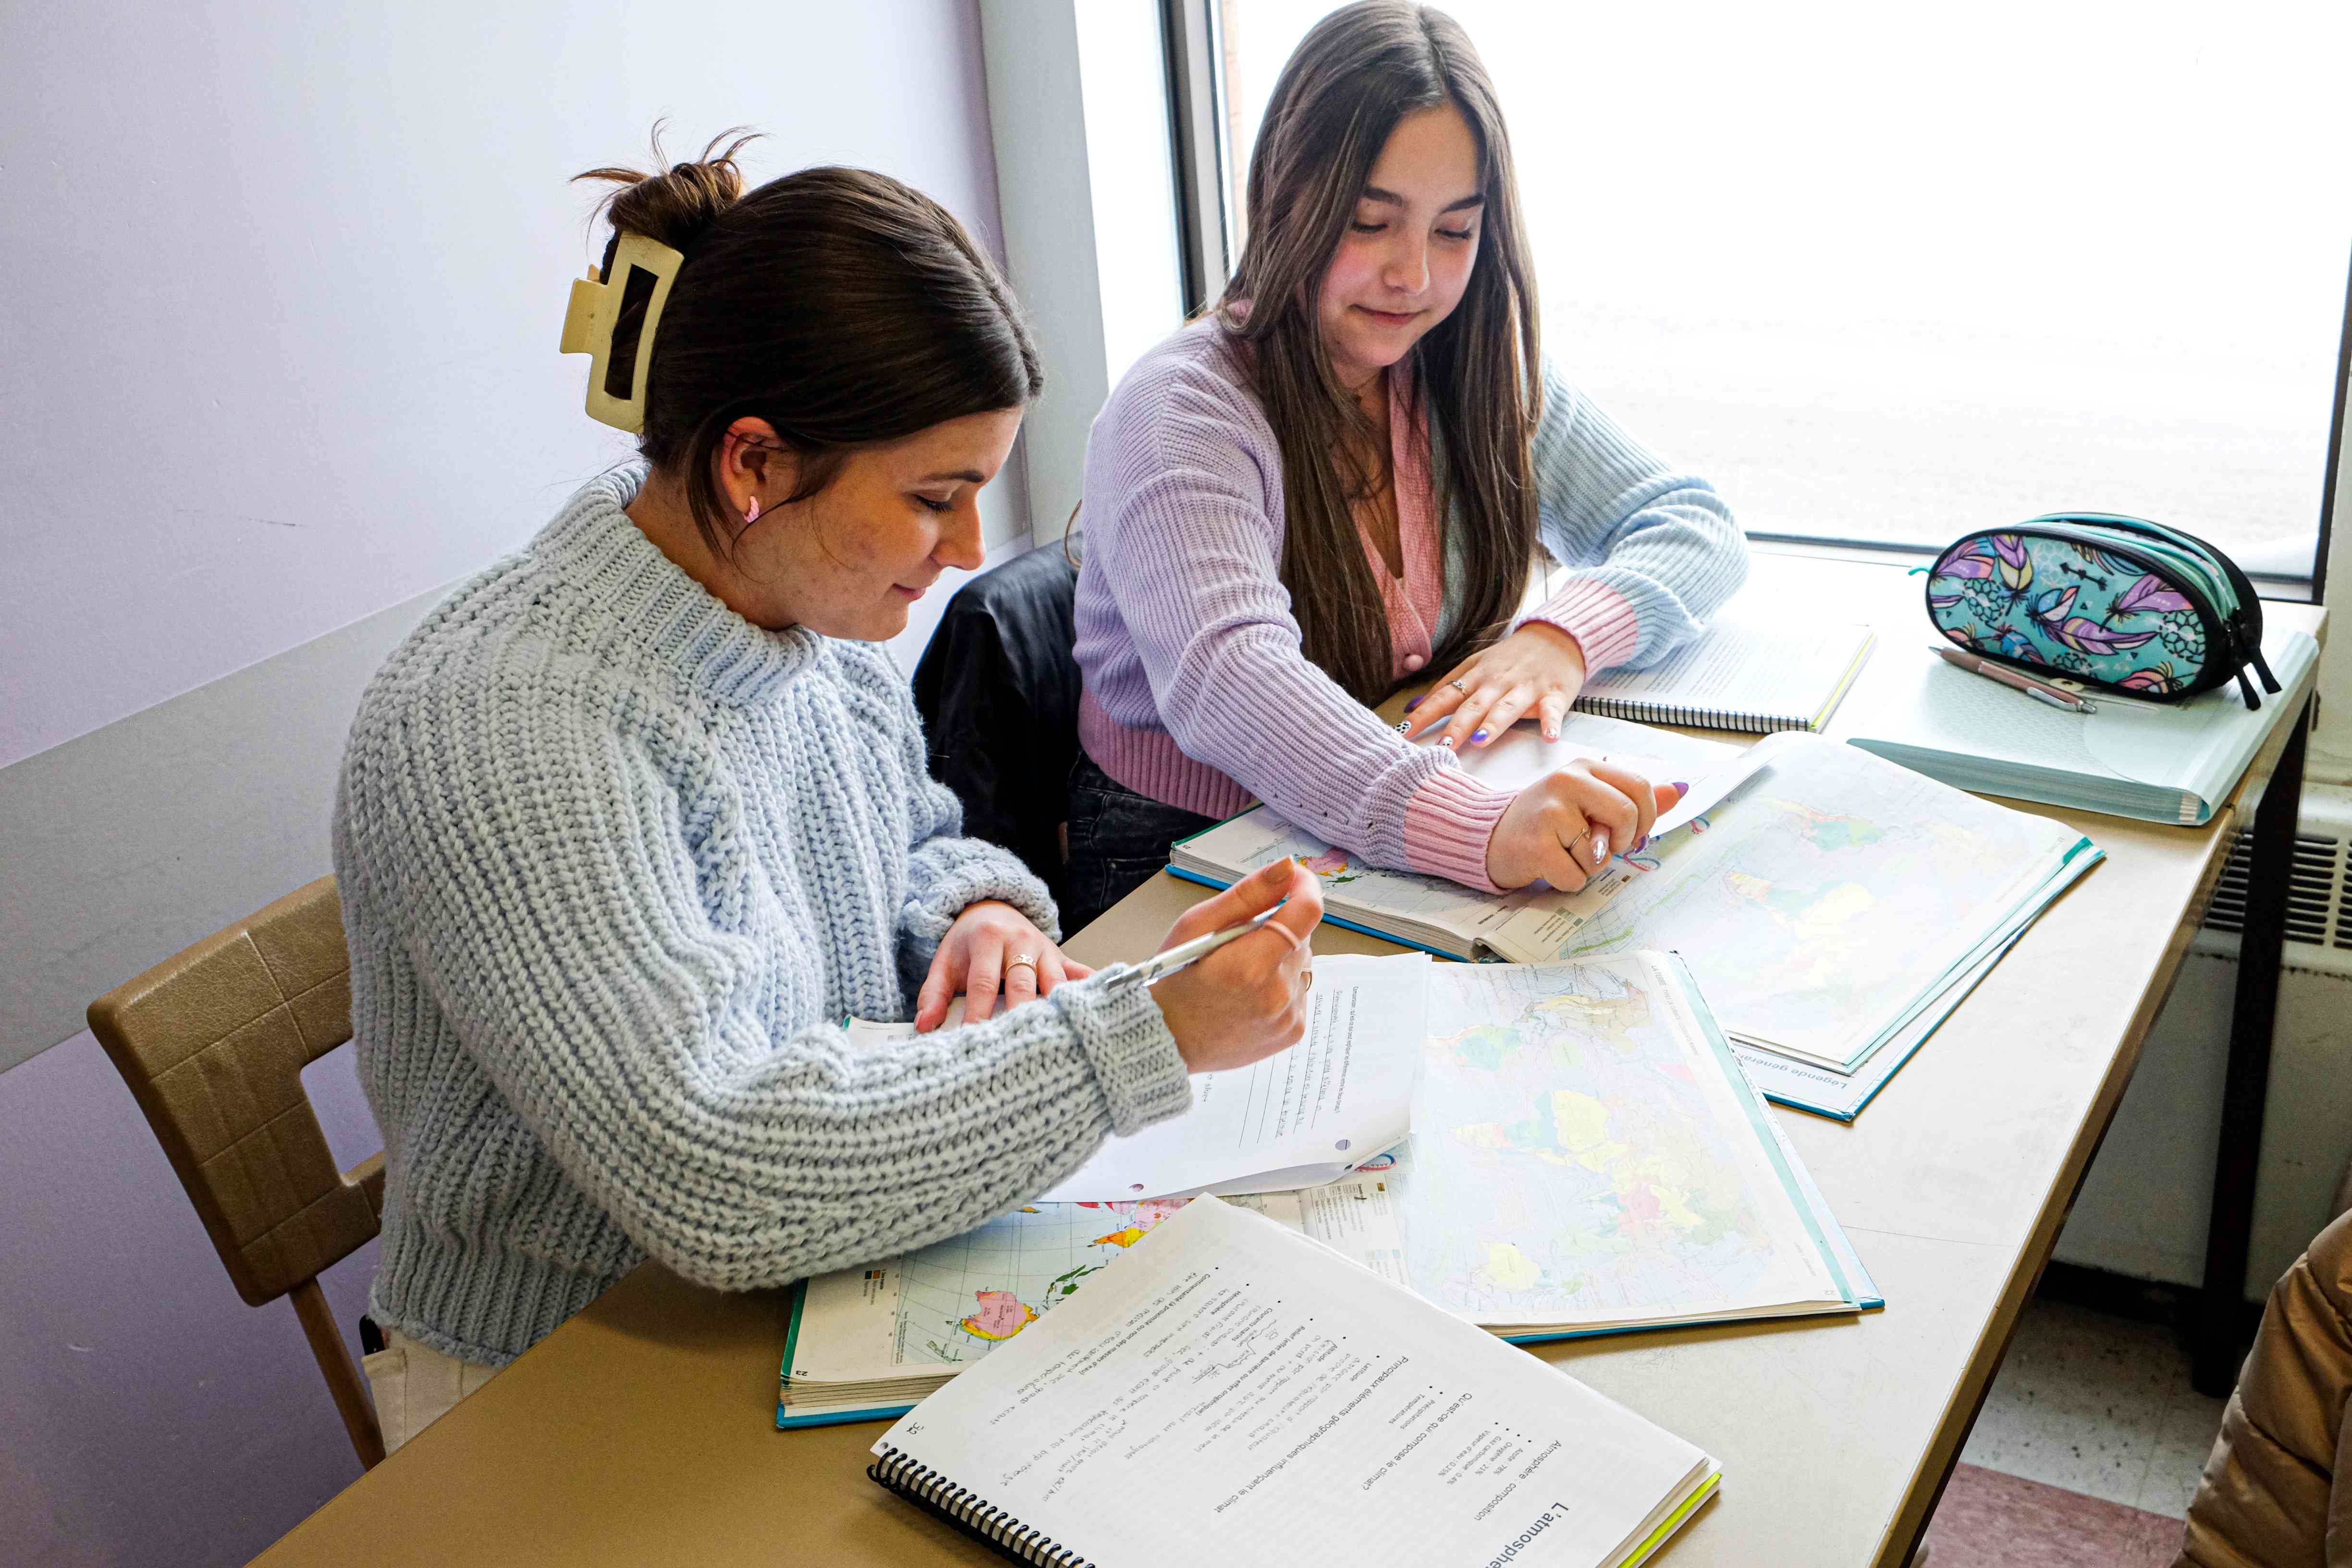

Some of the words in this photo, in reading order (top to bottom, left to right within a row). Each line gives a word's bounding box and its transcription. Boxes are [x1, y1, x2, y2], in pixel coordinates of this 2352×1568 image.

[1740, 1054, 1789, 1071] généra
[1791, 1069, 1848, 1089] Légende
[1174, 1274, 1211, 1302] Continentalité
[1210, 1290, 1242, 1315] Hémisphère
[1144, 1305, 1170, 1325] proximité
[1249, 1308, 1273, 1327] Courants
[1126, 1331, 1138, 1340] non
[1231, 1326, 1250, 1342] marins
[1289, 1325, 1306, 1340] Relief
[1115, 1339, 1127, 1348] des
[1274, 1337, 1291, 1351] (effet
[1317, 1343, 1338, 1362] Altitude
[1096, 1347, 1117, 1362] masses
[1078, 1361, 1098, 1375] d'eau)
[1248, 1356, 1270, 1374] barrière
[1349, 1363, 1372, 1382] Latitude
[1370, 1356, 1409, 1389] Principaux
[1226, 1380, 1241, 1391] effet
[1195, 1390, 1228, 1416] orogénique)
[1338, 1388, 1372, 1416] éléments
[1388, 1394, 1425, 1424] Températures
[1437, 1393, 1472, 1422] Qu'est-ce
[1399, 1399, 1436, 1430] Précipitations
[906, 1422, 924, 1434] 32
[1286, 1415, 1340, 1459] géographiques
[1425, 1422, 1439, 1433] qui
[1394, 1433, 1427, 1461] compose
[1471, 1430, 1492, 1447] Vapeur
[1489, 1436, 1502, 1446] Gaz
[1456, 1446, 1472, 1460] d'eau
[1462, 1445, 1491, 1470] carbonique
[1489, 1442, 1513, 1462] Oxygène
[1507, 1447, 1523, 1462] Azote
[1519, 1440, 1562, 1479] Atmosphère
[1246, 1458, 1288, 1490] influençant
[1446, 1472, 1463, 1485] 0.4%
[1474, 1464, 1489, 1475] 21%
[1493, 1464, 1507, 1476] 78%
[1363, 1468, 1388, 1491] climat?
[1214, 1495, 1239, 1513] climat
[1474, 1483, 1517, 1521] composition
